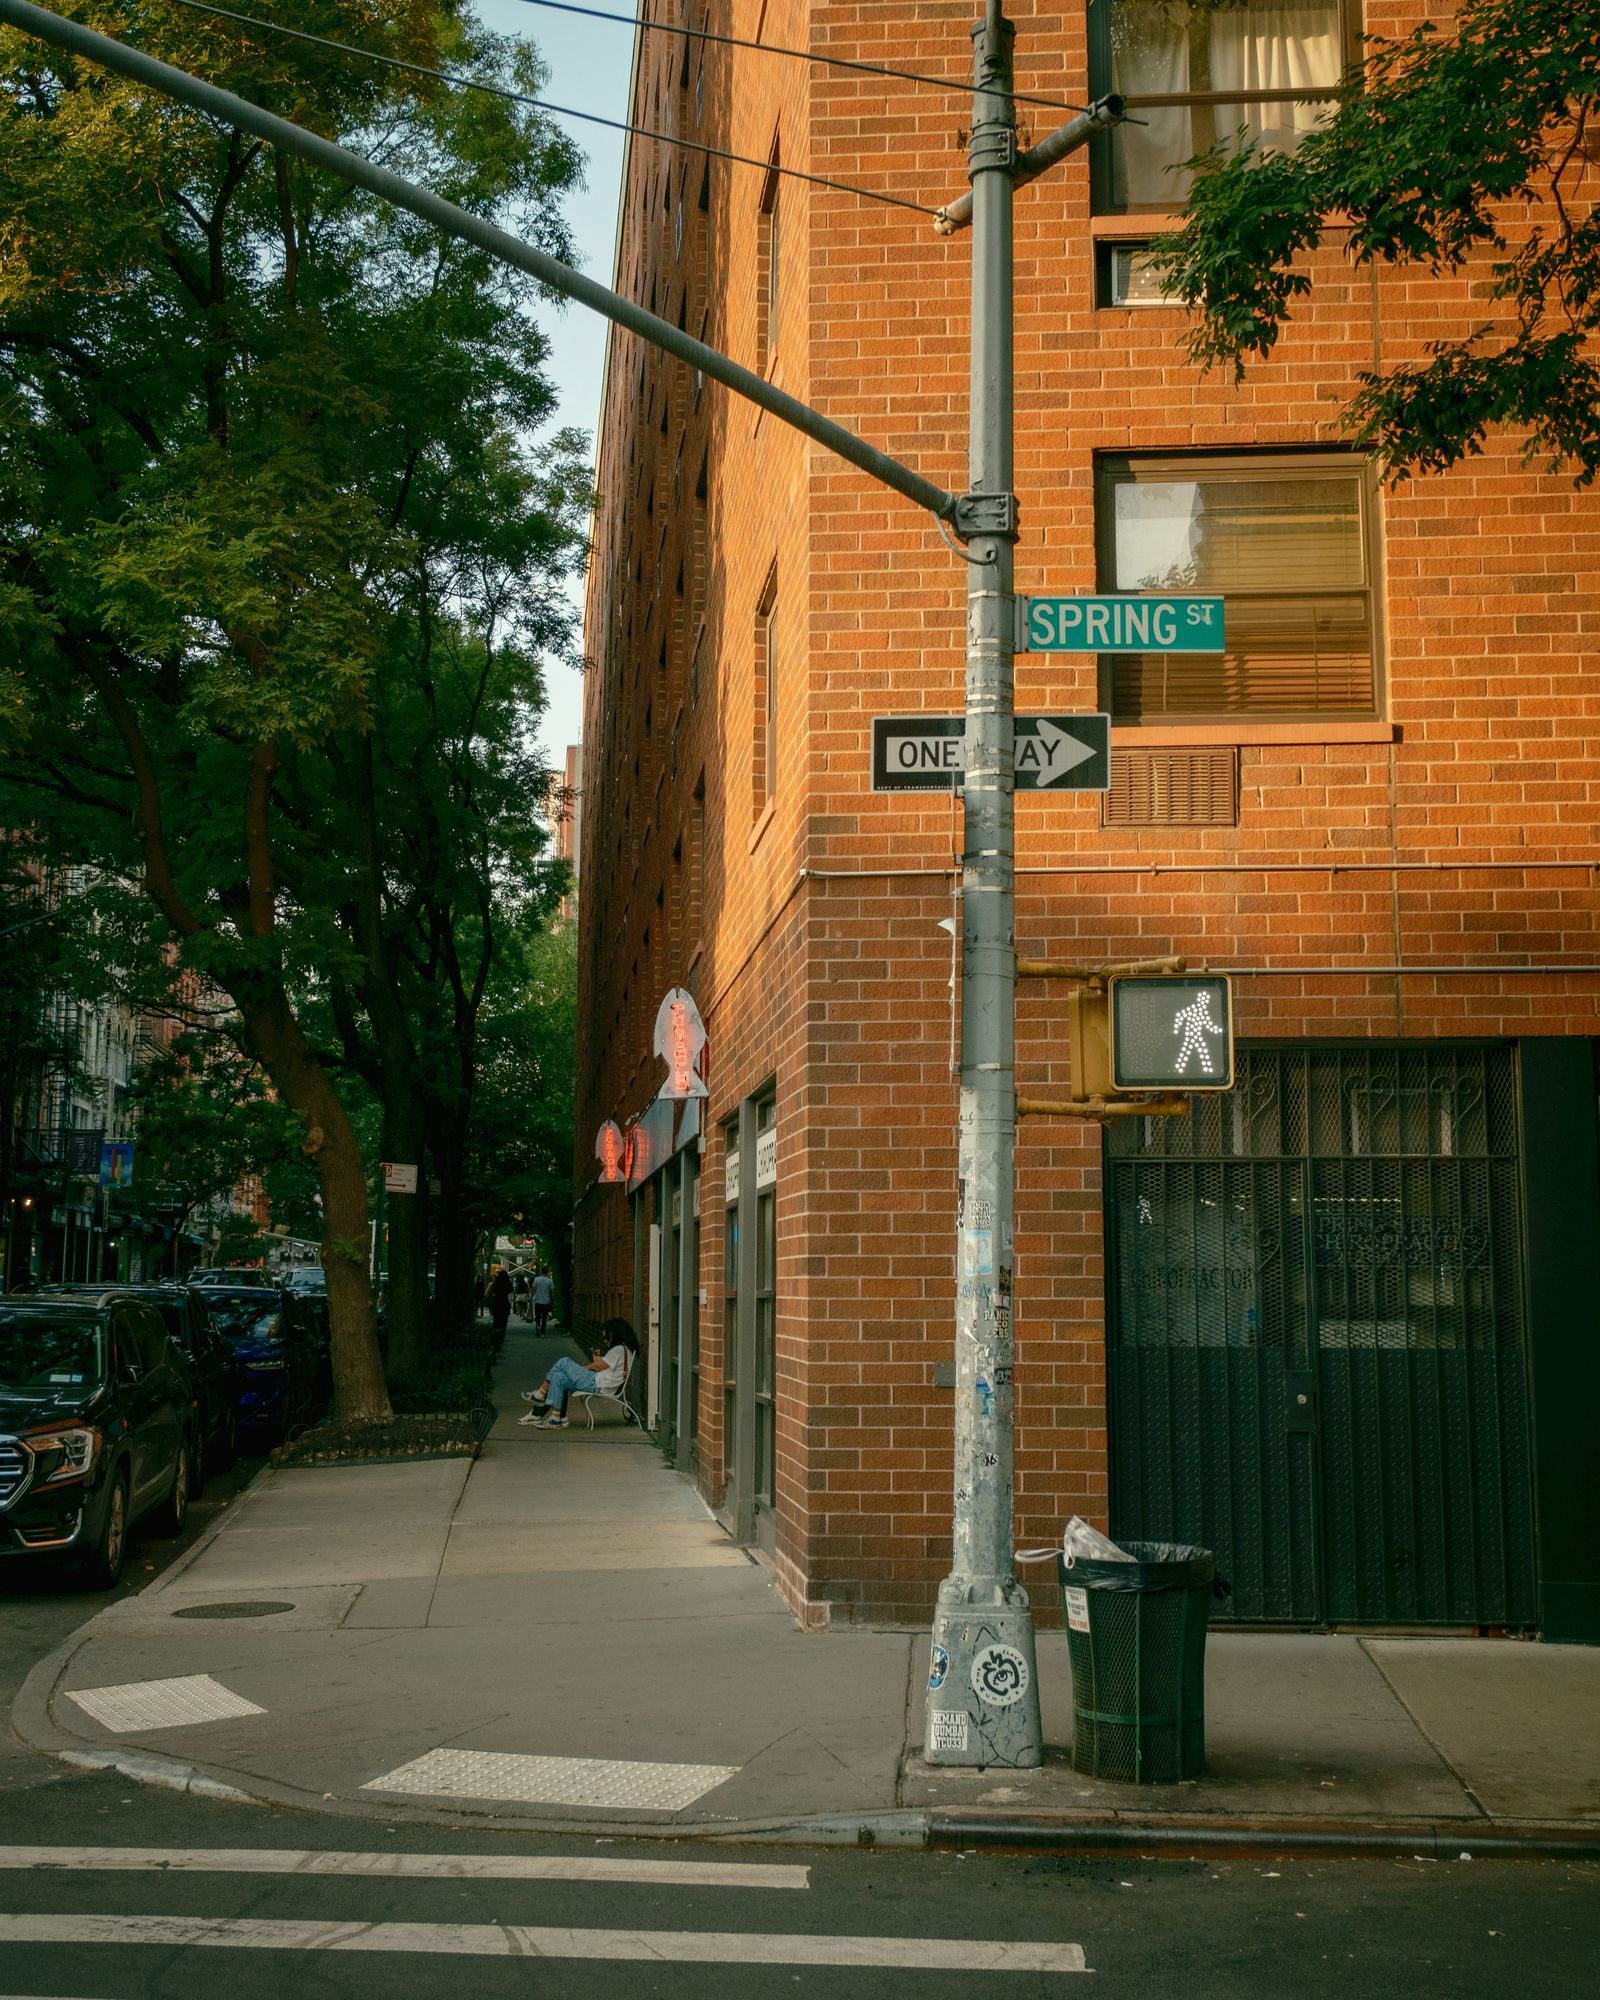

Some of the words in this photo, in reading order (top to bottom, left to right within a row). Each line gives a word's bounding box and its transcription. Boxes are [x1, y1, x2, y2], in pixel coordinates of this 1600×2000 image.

[1031, 603, 1177, 646] SPRING
[1186, 604, 1215, 626] ST
[899, 740, 960, 768] ONE
[1014, 739, 1061, 767] AY
[604, 1129, 617, 1181] TOMBOLO
[933, 1711, 967, 1725] REMAND
[934, 1724, 964, 1737] GUMBA
